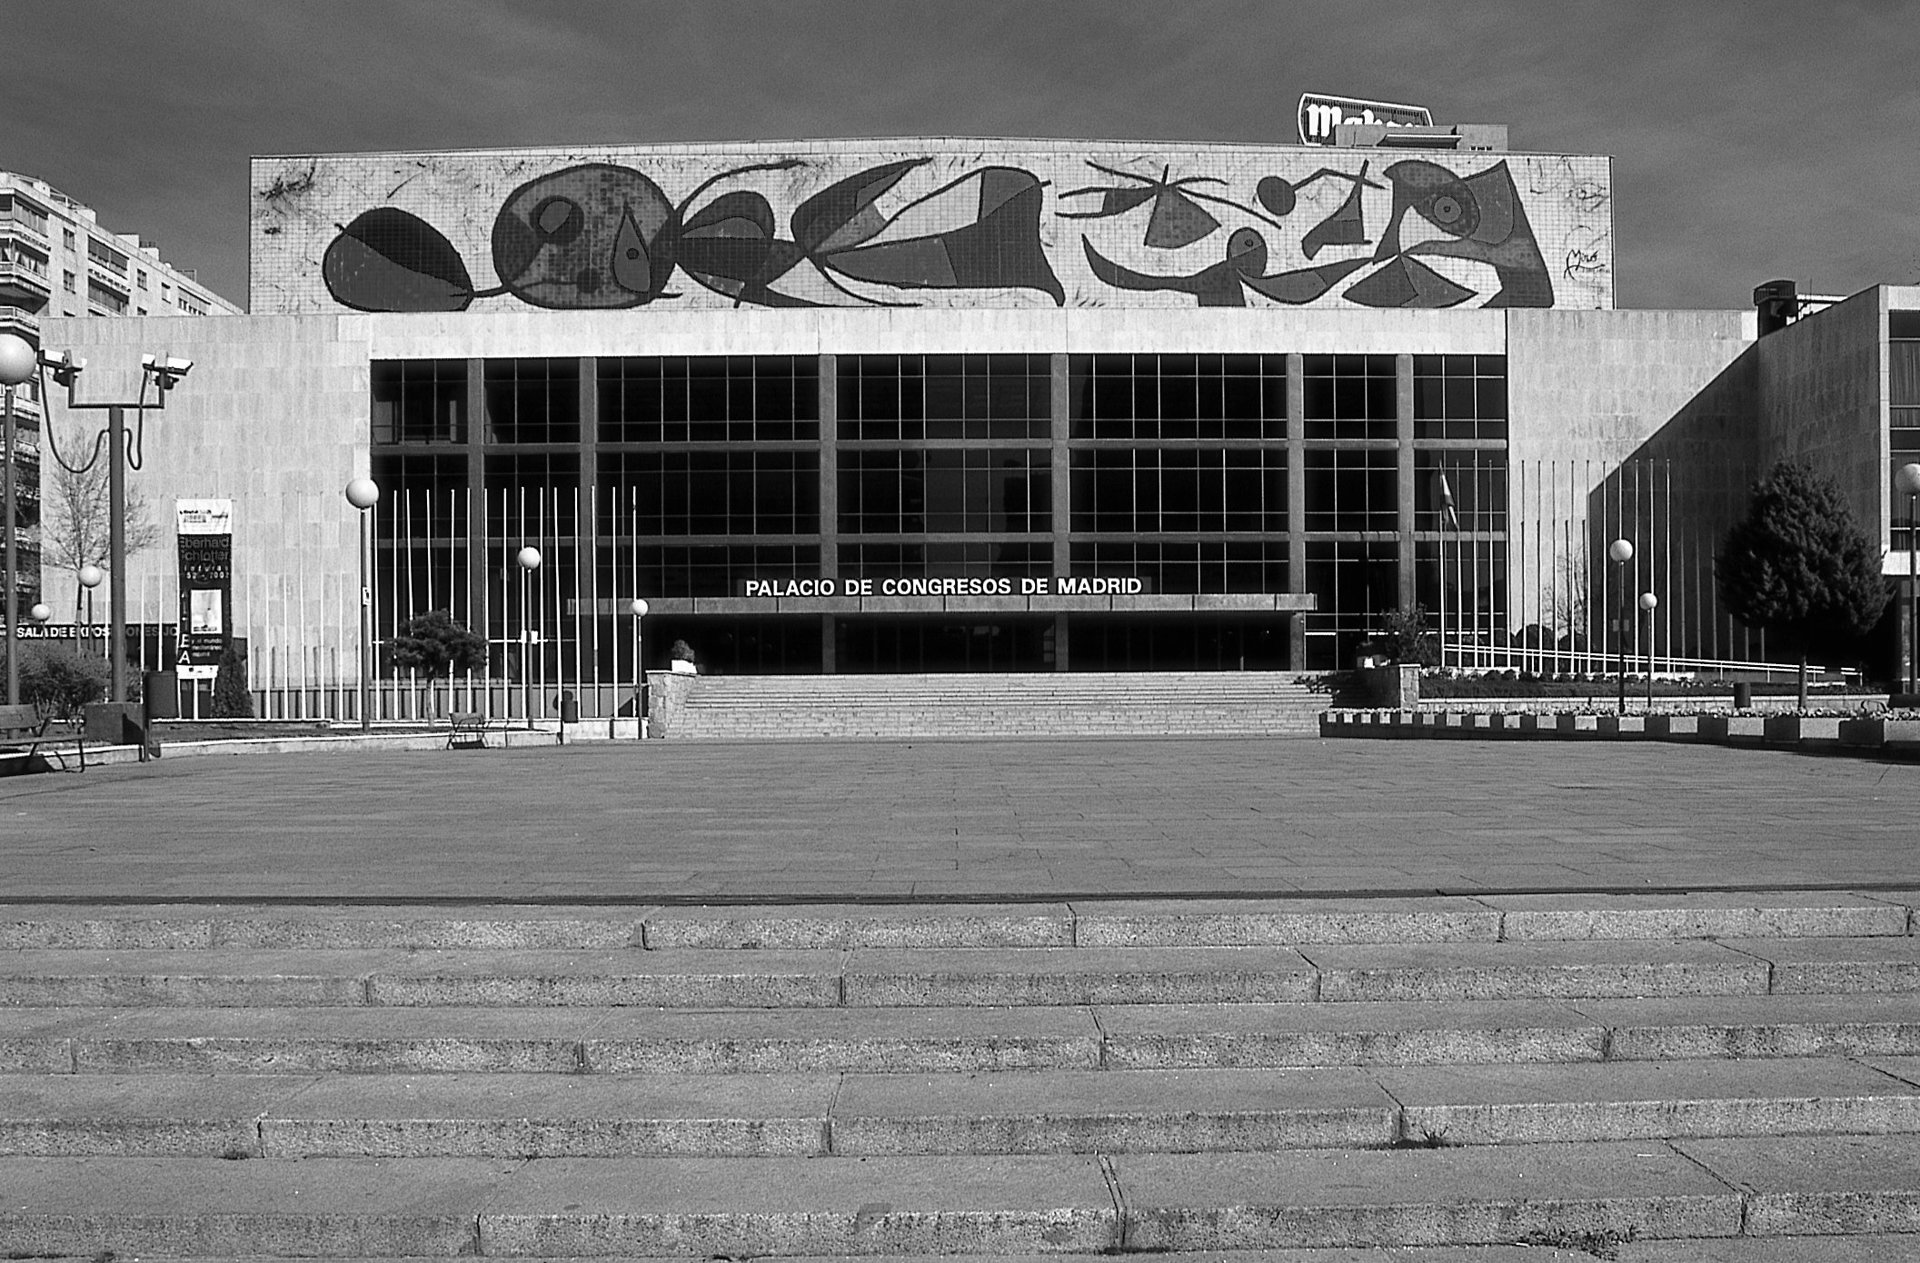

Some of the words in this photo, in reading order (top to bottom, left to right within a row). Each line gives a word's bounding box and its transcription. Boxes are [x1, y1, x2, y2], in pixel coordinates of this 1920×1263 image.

[746, 579, 835, 597] PALACIO
[845, 579, 873, 596] DE
[882, 578, 1011, 595] CONGRESOS
[1021, 578, 1048, 594] DE
[1058, 577, 1142, 594] MADRID
